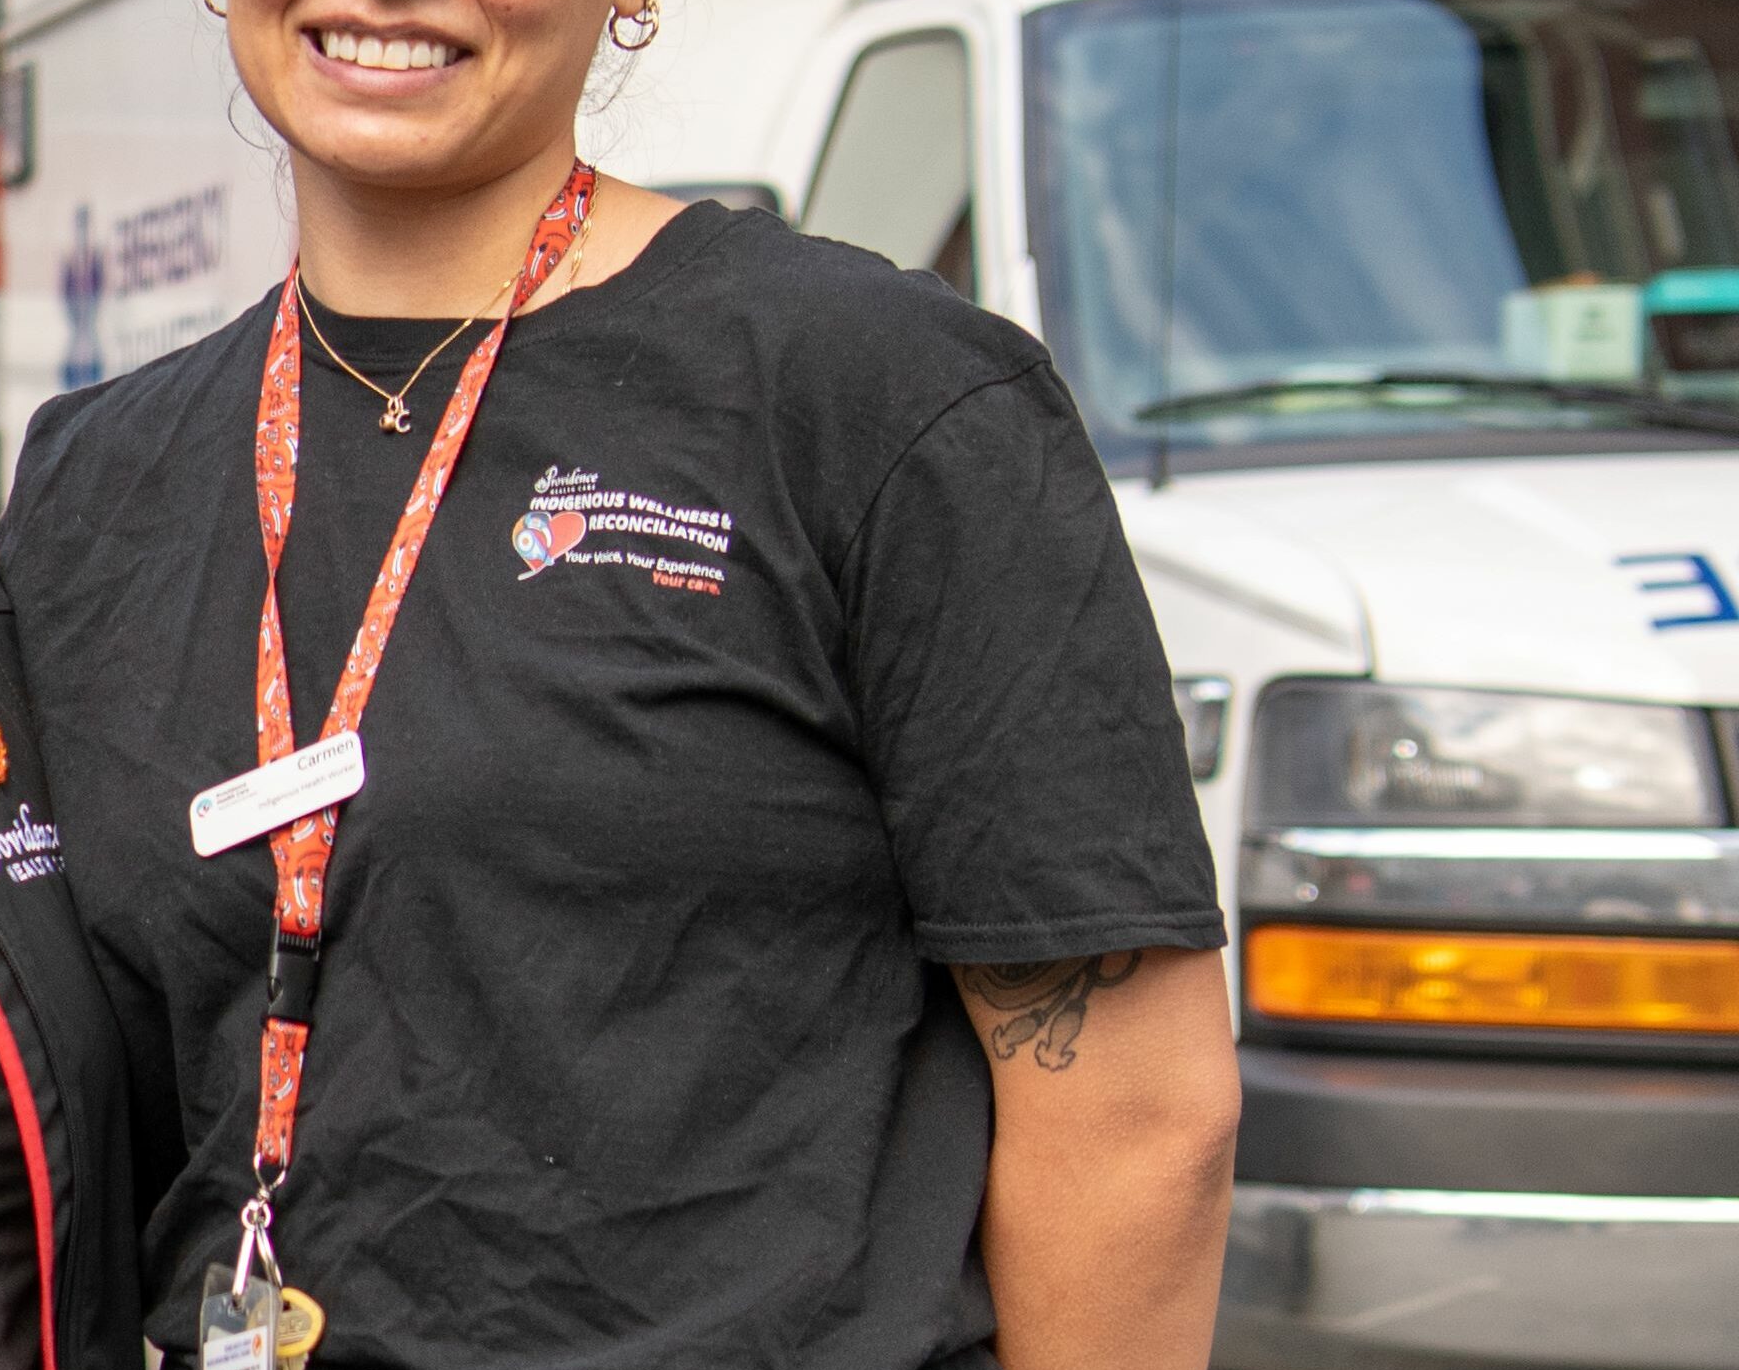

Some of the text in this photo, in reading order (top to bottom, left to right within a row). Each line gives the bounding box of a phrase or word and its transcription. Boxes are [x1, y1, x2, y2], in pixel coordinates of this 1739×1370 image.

[529, 491, 627, 511] INDIGENOUS
[628, 494, 720, 528] WELLNESS
[588, 514, 729, 553] RECONCILIATION
[565, 551, 592, 563] Your
[626, 553, 655, 569] Your
[656, 557, 725, 581] Experience.
[652, 571, 685, 588] Your
[297, 738, 355, 771] Carmen
